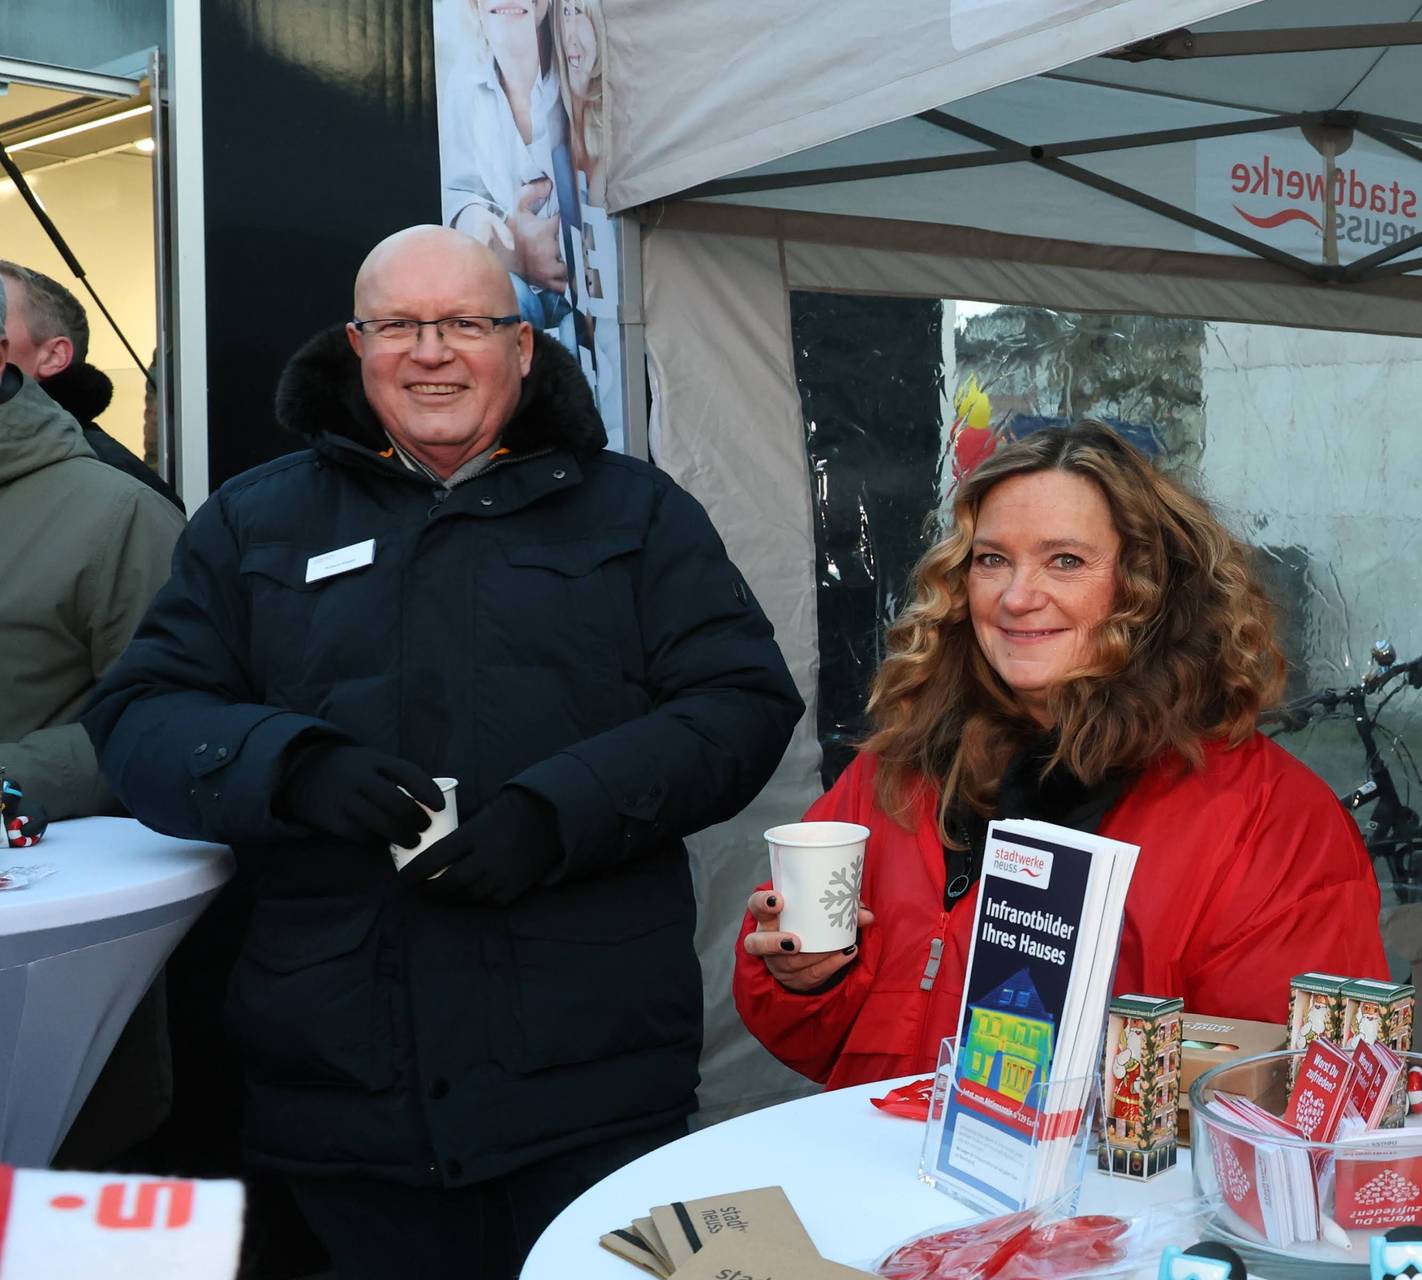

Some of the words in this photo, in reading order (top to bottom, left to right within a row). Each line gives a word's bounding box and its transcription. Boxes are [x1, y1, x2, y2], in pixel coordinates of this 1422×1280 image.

[993, 859, 1017, 873] neuss
[994, 847, 1044, 870] stadtwerke
[985, 897, 1074, 941] Infrarotbilder
[982, 922, 1016, 949] Ihres
[1019, 934, 1066, 966] Hauses
[1313, 1053, 1331, 1073] Warst
[1330, 1063, 1340, 1078] Du
[1305, 1068, 1336, 1095] zufrieden?
[1354, 1217, 1373, 1225] Du
[1376, 1213, 1416, 1226] Warst
